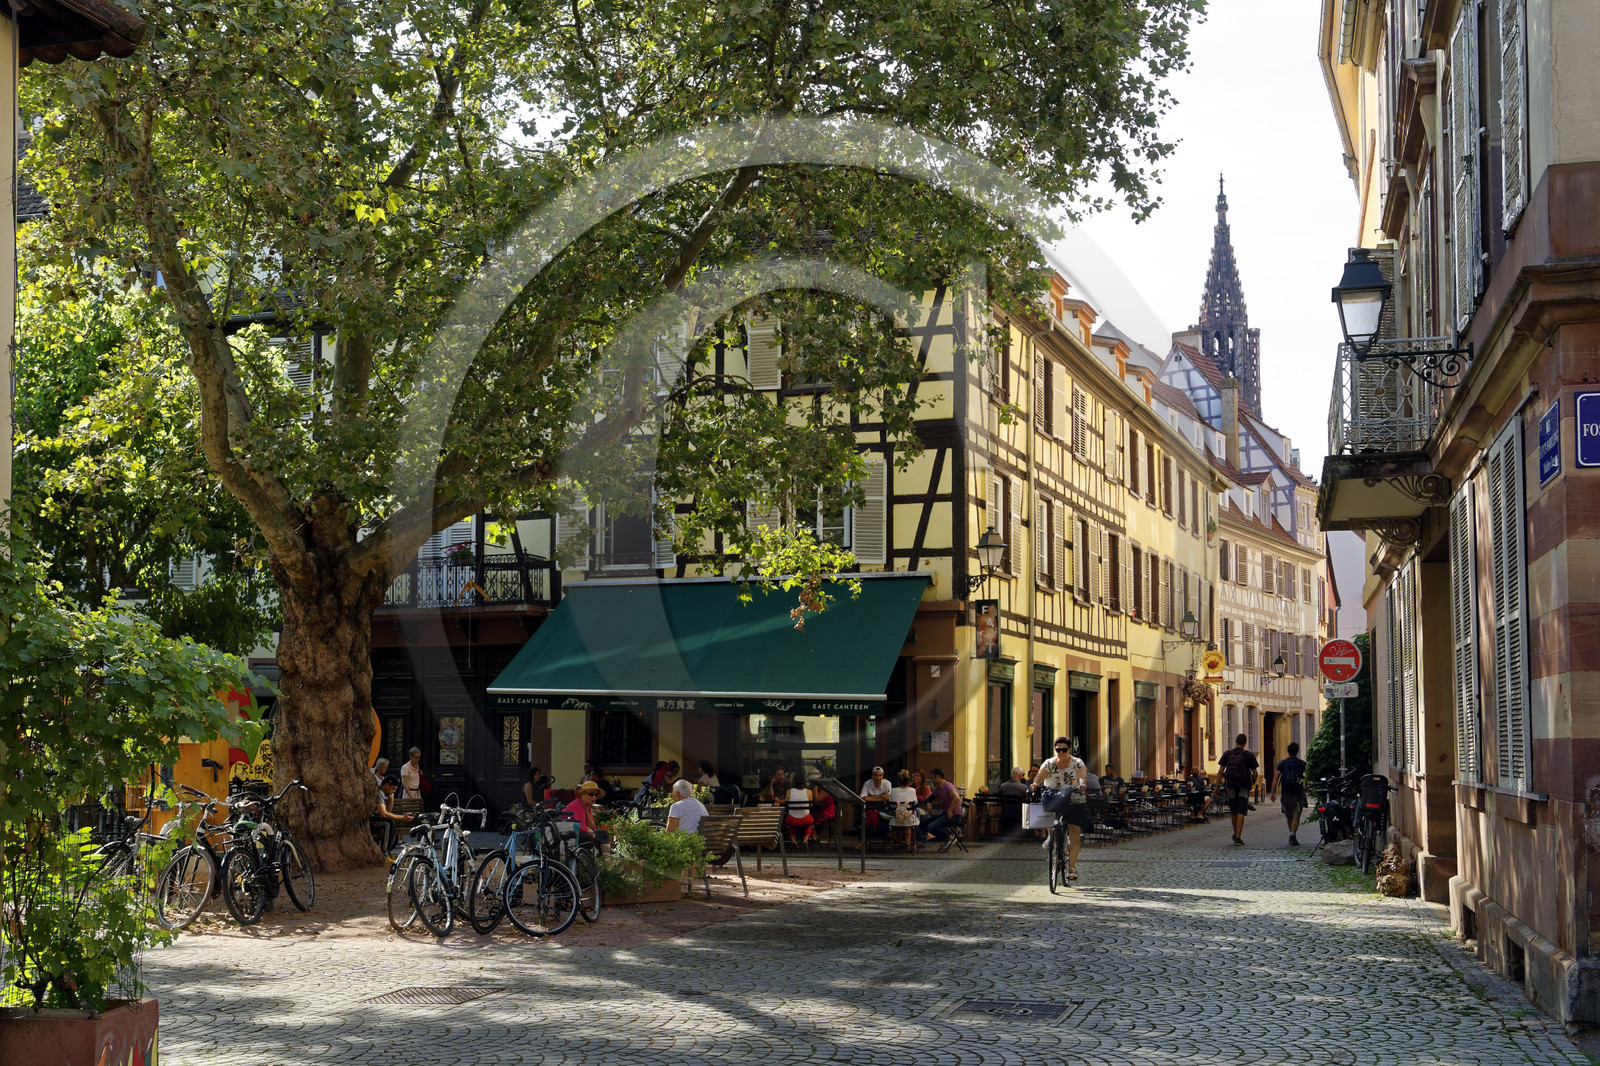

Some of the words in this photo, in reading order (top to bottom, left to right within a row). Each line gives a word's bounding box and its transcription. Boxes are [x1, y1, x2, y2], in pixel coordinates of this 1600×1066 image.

[1583, 423, 1600, 437] FO
[656, 699, 695, 710] 東方食堂
